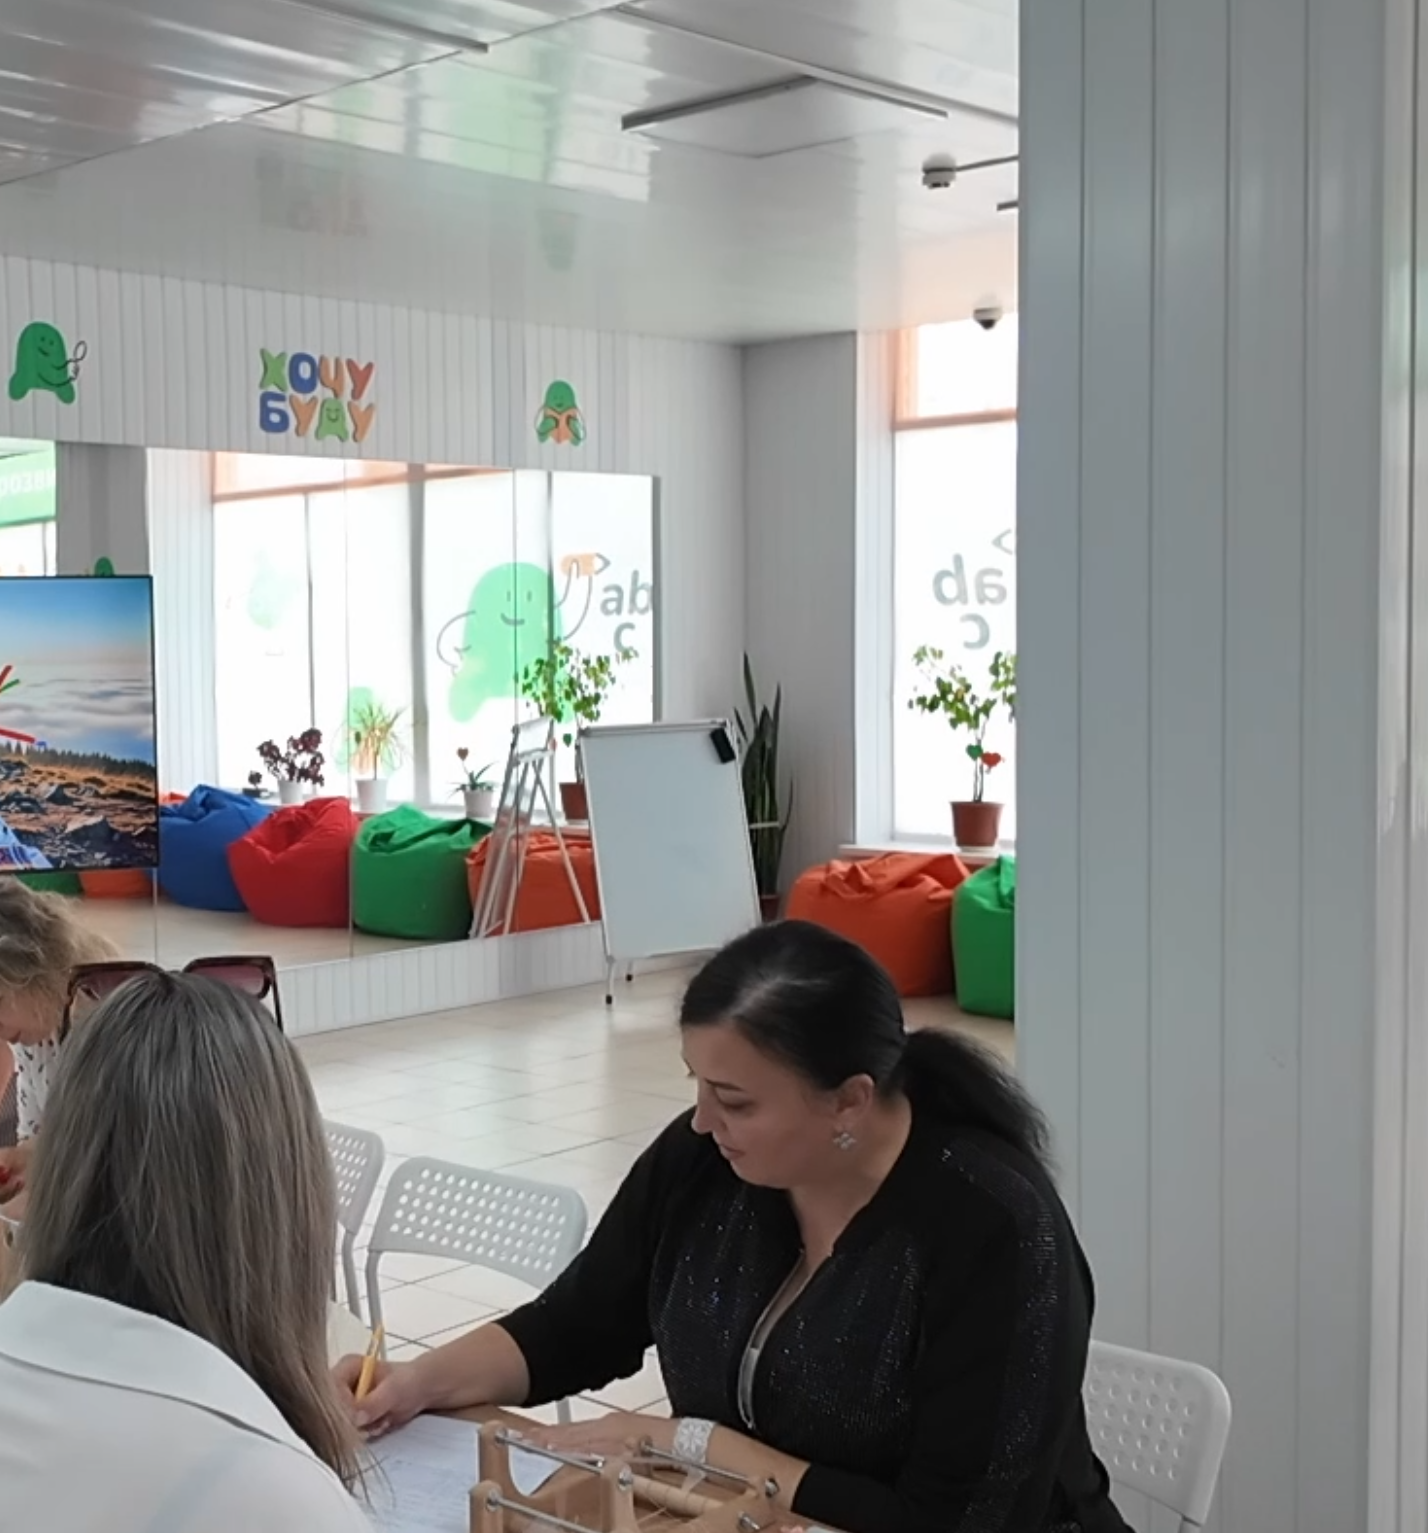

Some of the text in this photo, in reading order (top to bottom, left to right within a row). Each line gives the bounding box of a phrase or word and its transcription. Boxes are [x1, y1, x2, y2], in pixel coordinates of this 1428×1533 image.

[259, 348, 375, 401] ХОЧУ
[259, 391, 375, 442] БУДУ
[600, 569, 652, 616] ab
